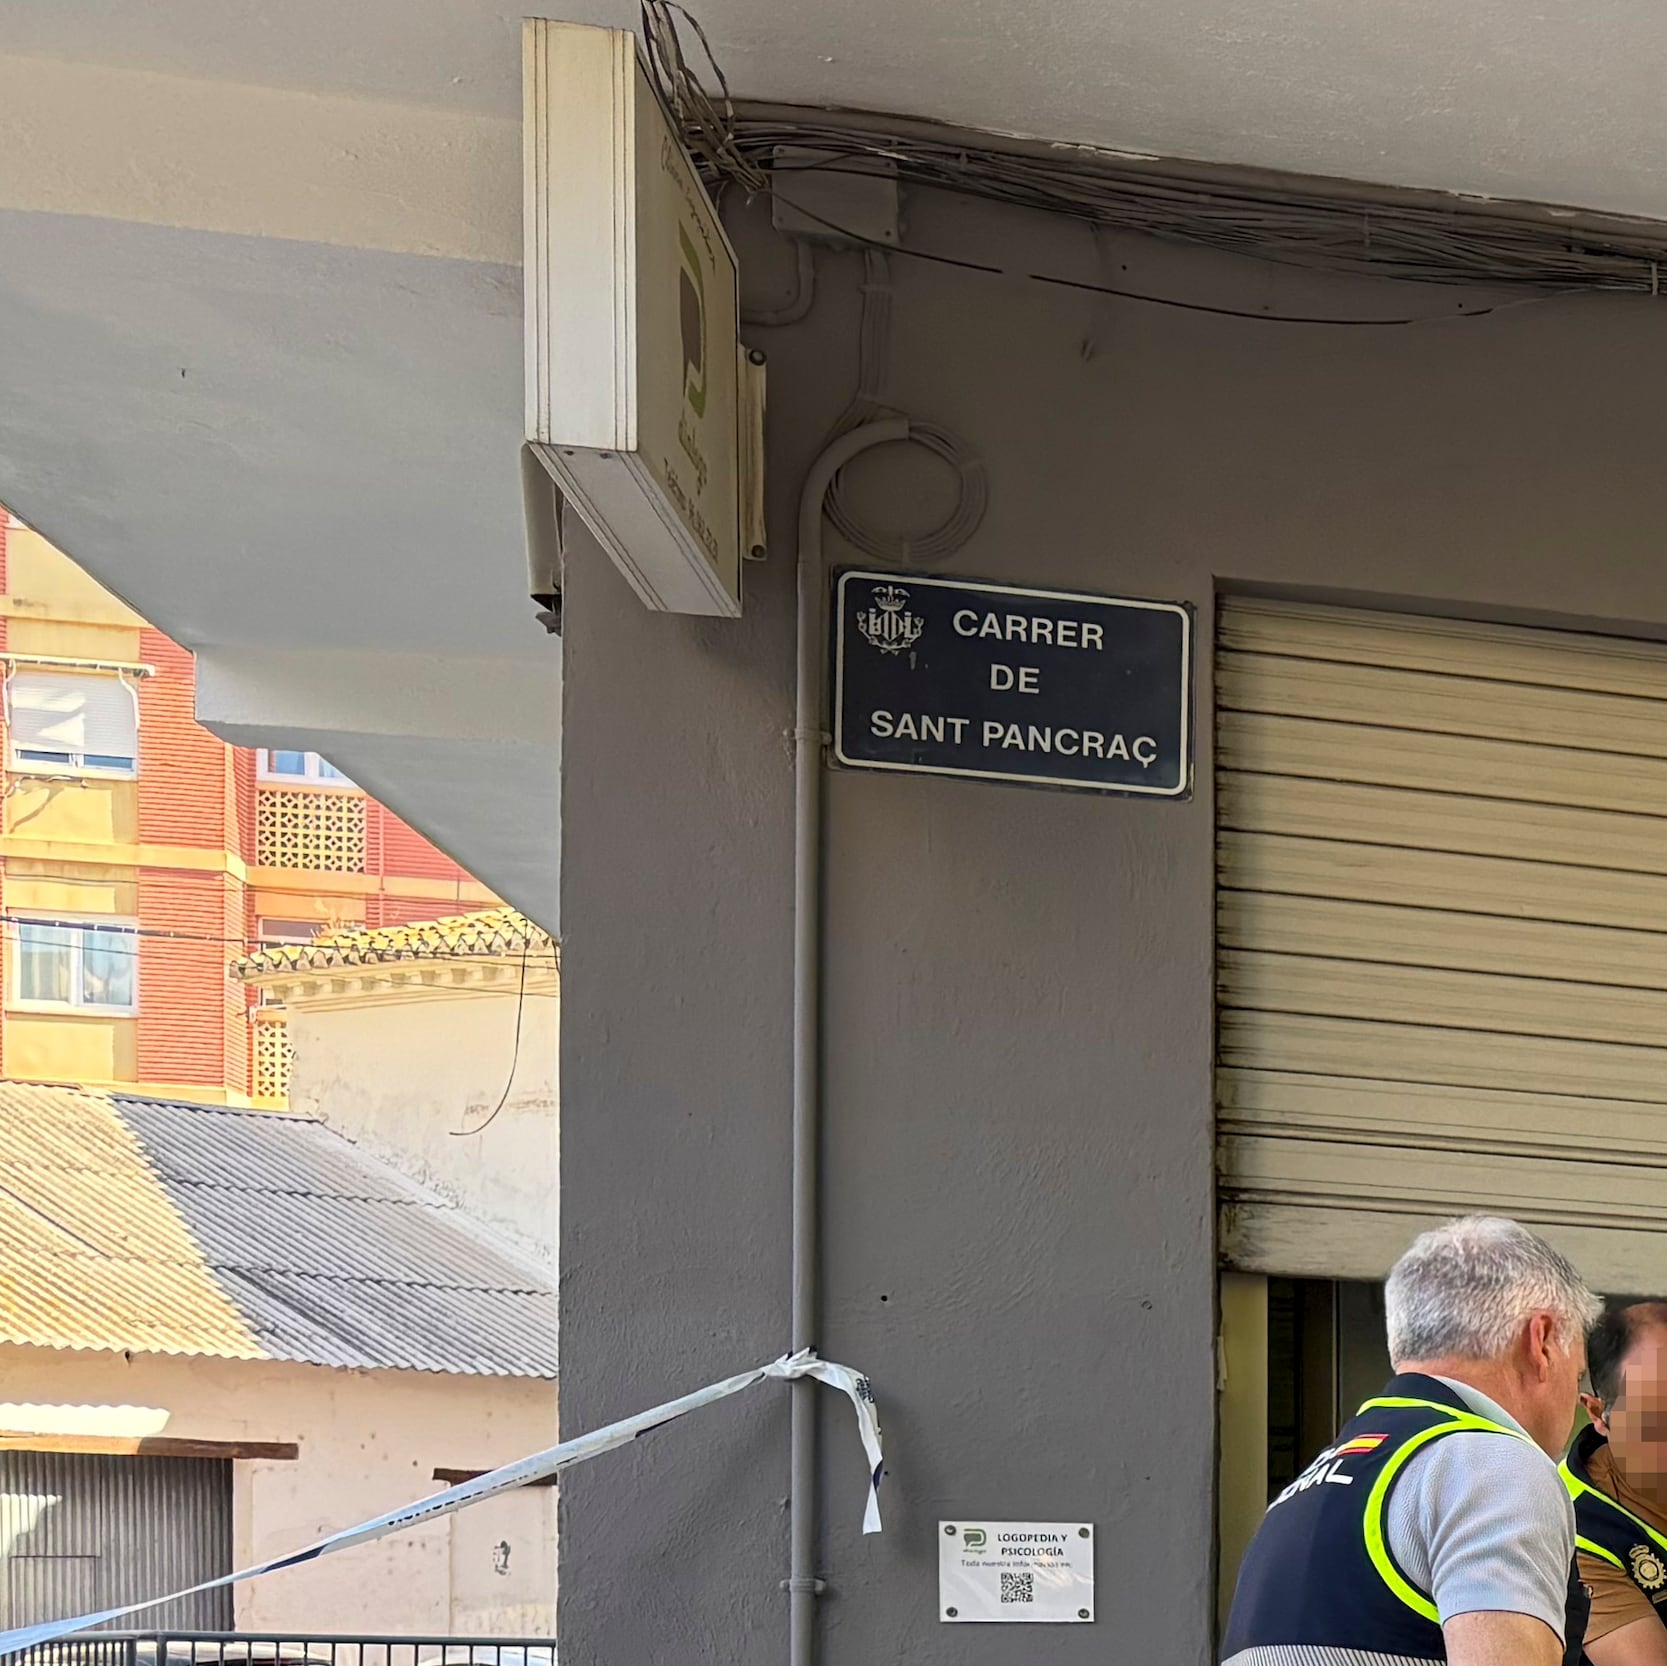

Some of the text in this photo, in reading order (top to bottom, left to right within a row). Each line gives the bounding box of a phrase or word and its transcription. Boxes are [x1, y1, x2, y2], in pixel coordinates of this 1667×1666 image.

[953, 609, 1103, 650] CARRER
[990, 664, 1040, 694] DE
[870, 709, 1157, 768] SANT PANCRAÇ
[1001, 1546, 1064, 1556] PSICOLOGÍA
[1060, 1534, 1068, 1542] Y
